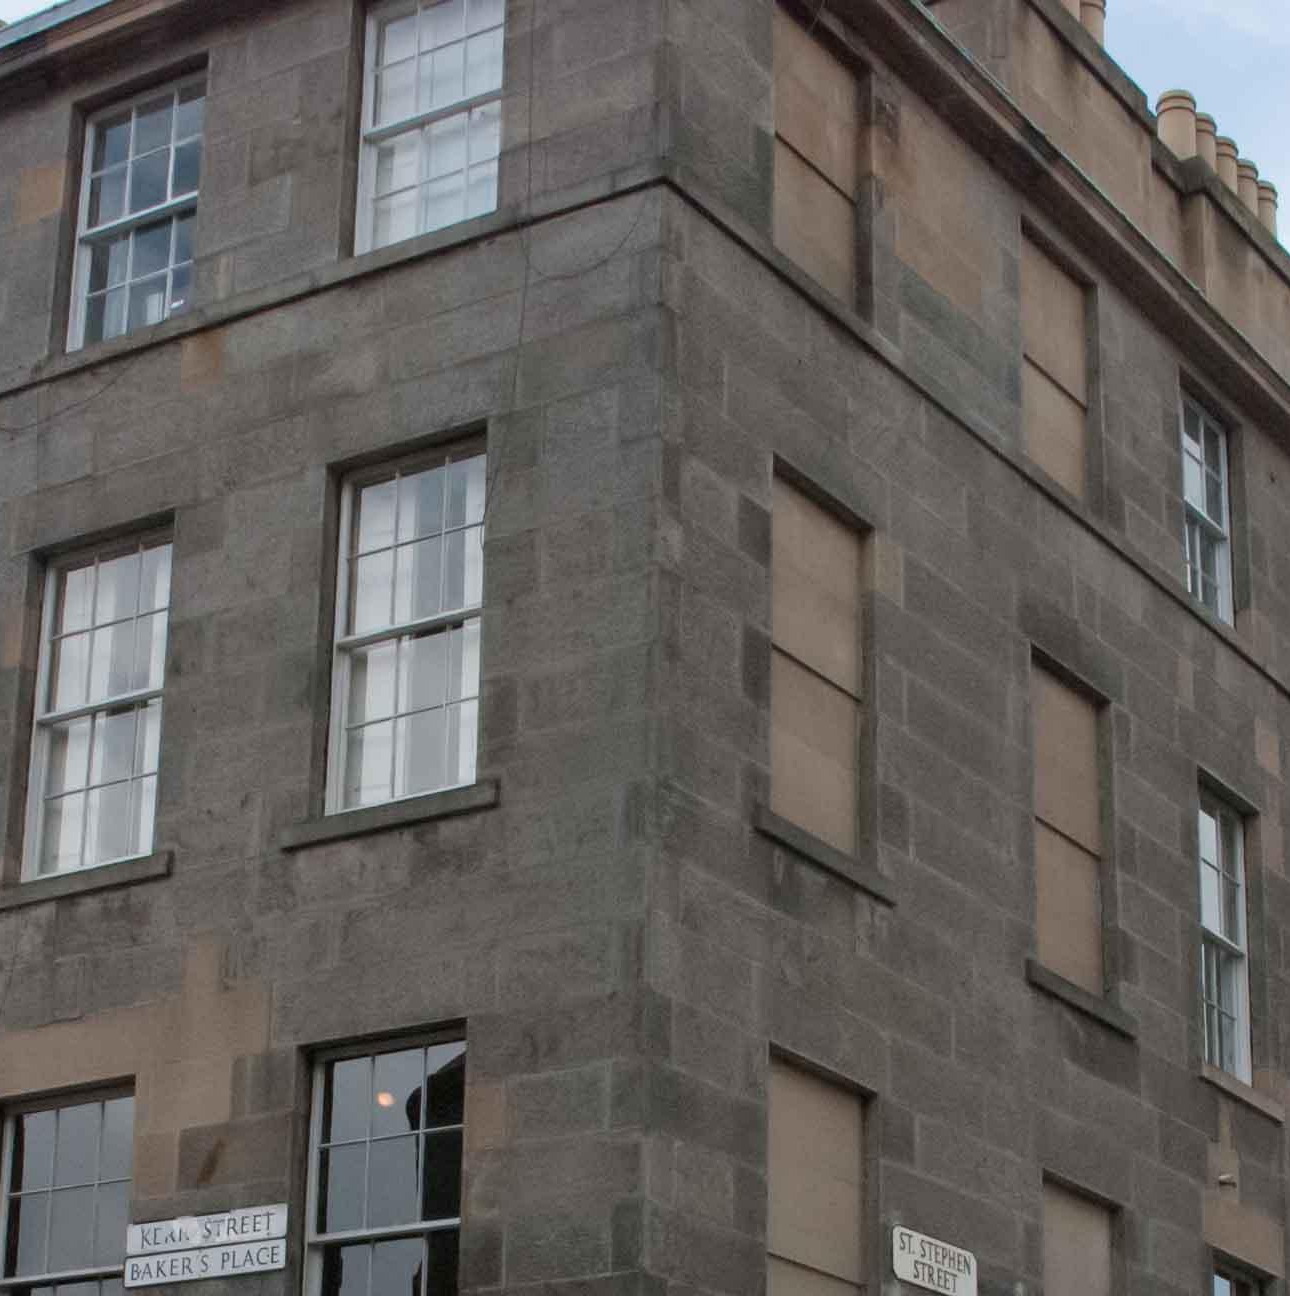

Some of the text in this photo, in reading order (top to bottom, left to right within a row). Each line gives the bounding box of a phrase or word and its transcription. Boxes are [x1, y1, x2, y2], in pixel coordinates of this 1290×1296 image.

[203, 1211, 277, 1239] STREET
[130, 1246, 281, 1281] BAKER'S PLACE
[920, 1240, 972, 1275] STEPHEN
[913, 1260, 958, 1293] STREET
